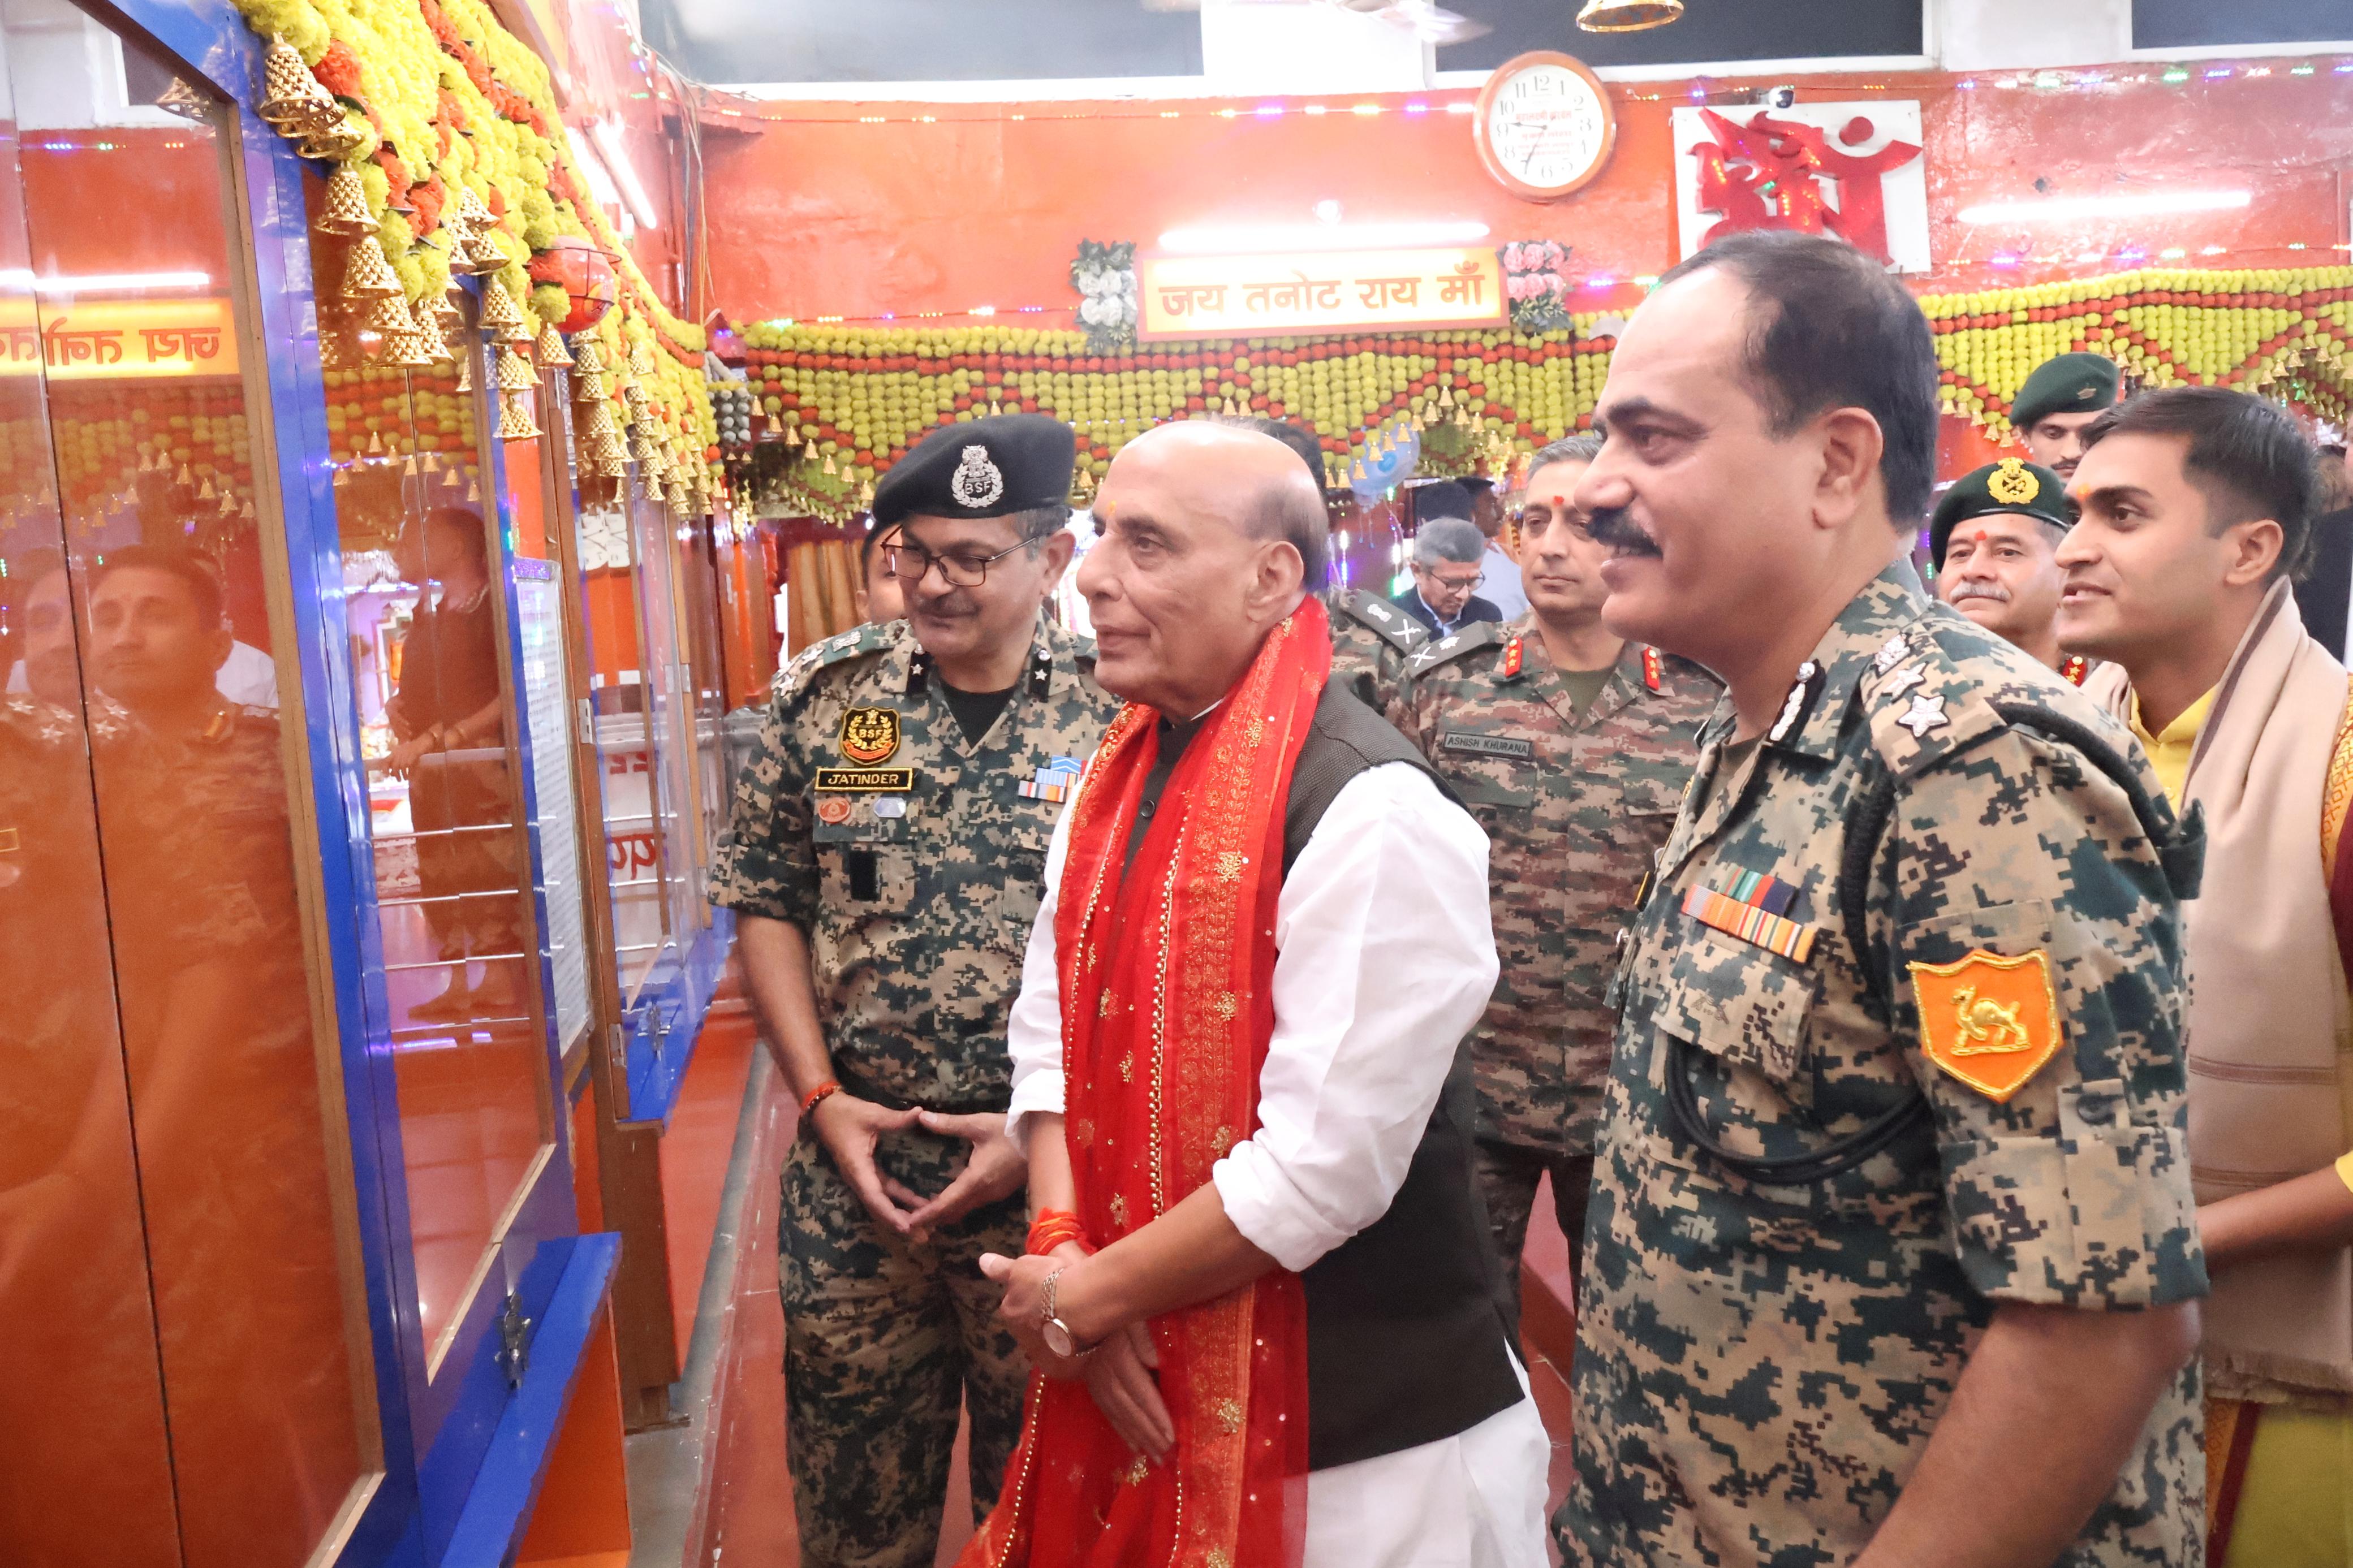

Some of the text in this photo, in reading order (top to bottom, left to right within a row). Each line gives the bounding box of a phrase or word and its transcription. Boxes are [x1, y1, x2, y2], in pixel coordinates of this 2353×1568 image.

[1515, 83, 1527, 98] 11
[1534, 75, 1550, 91] 12
[1560, 80, 1565, 96] 1
[1500, 100, 1515, 115] 10
[1574, 95, 1584, 110] 2
[1496, 122, 1509, 137] 9
[1580, 117, 1592, 132] 3
[1504, 144, 1516, 159] 8
[1520, 159, 1529, 175] 7
[1541, 164, 1553, 179] 6
[1159, 260, 1485, 317] जय तनोट राय माँ
[964, 481, 992, 494] BSF
[859, 729, 883, 738] BSF
[1447, 736, 1527, 754] ASHISH KHURANA
[828, 774, 899, 785] JATINDER
